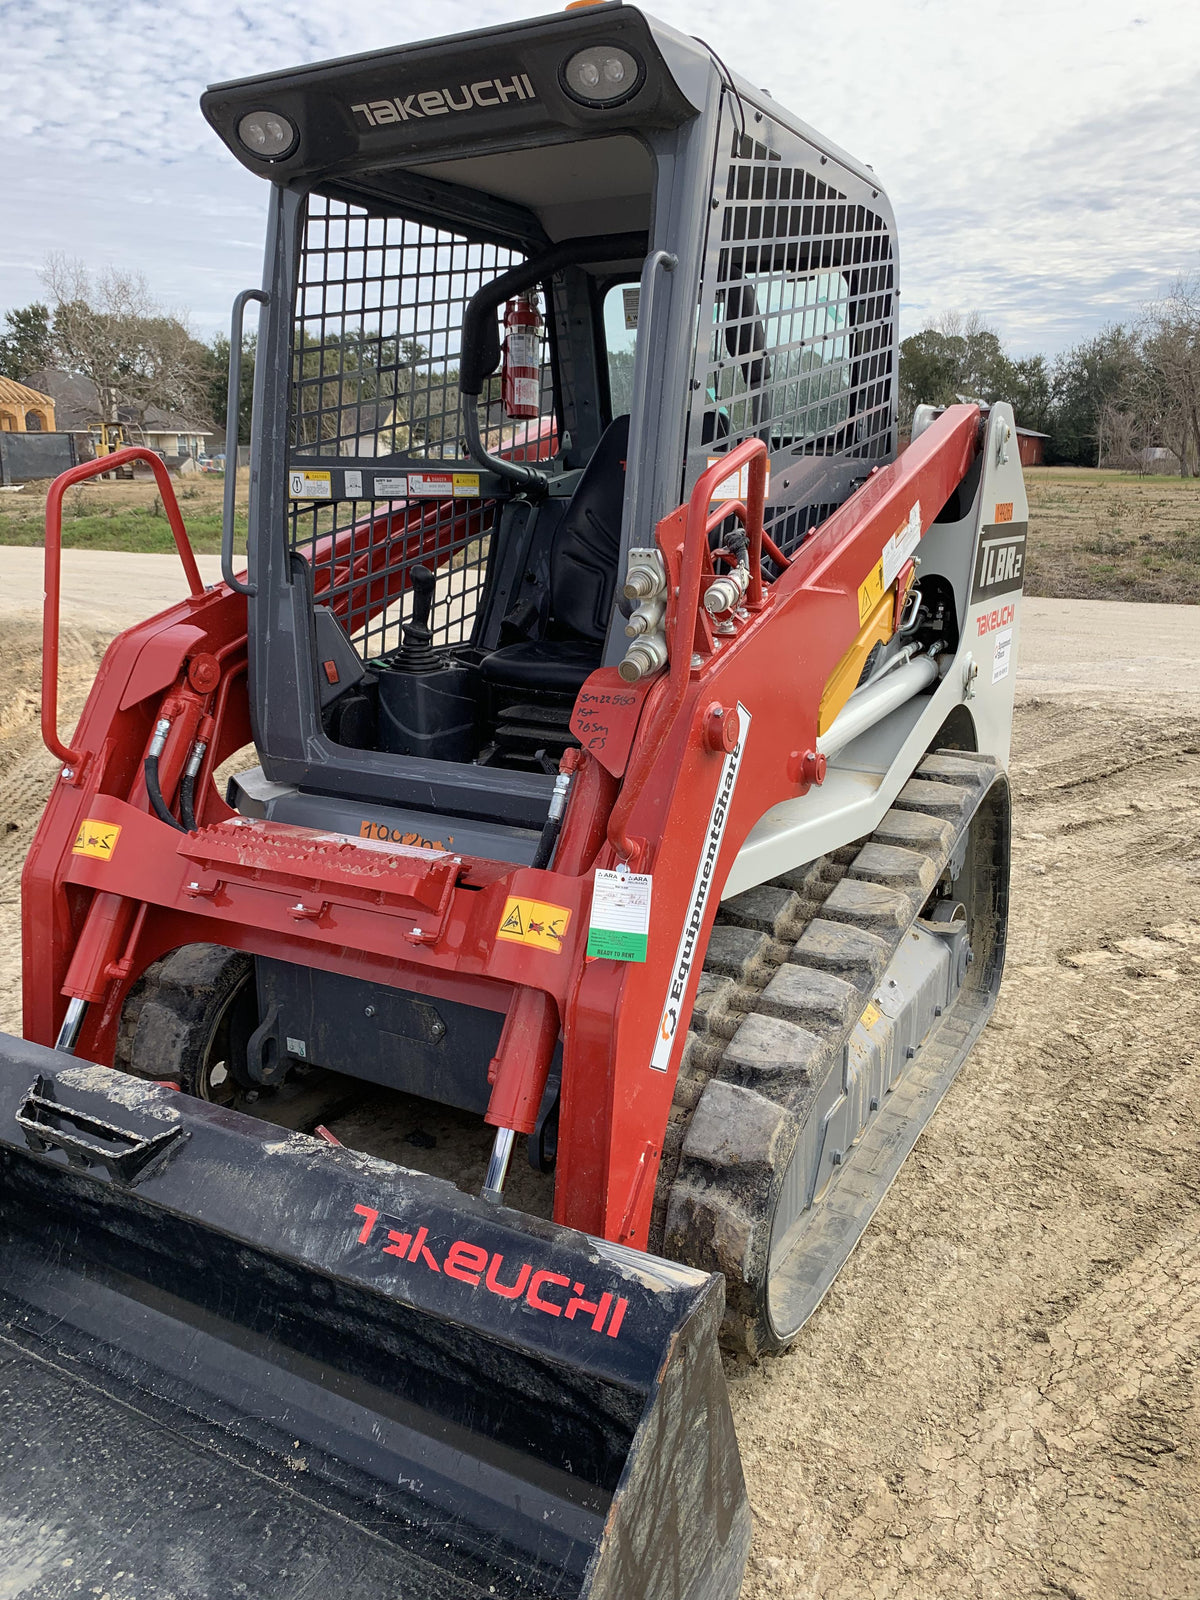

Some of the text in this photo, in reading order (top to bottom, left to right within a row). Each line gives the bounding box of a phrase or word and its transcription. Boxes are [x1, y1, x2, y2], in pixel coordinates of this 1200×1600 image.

[350, 73, 536, 126] TAKEUCHI
[976, 603, 1015, 637] TAKEUCHI
[670, 741, 741, 1003] EquipmentShare
